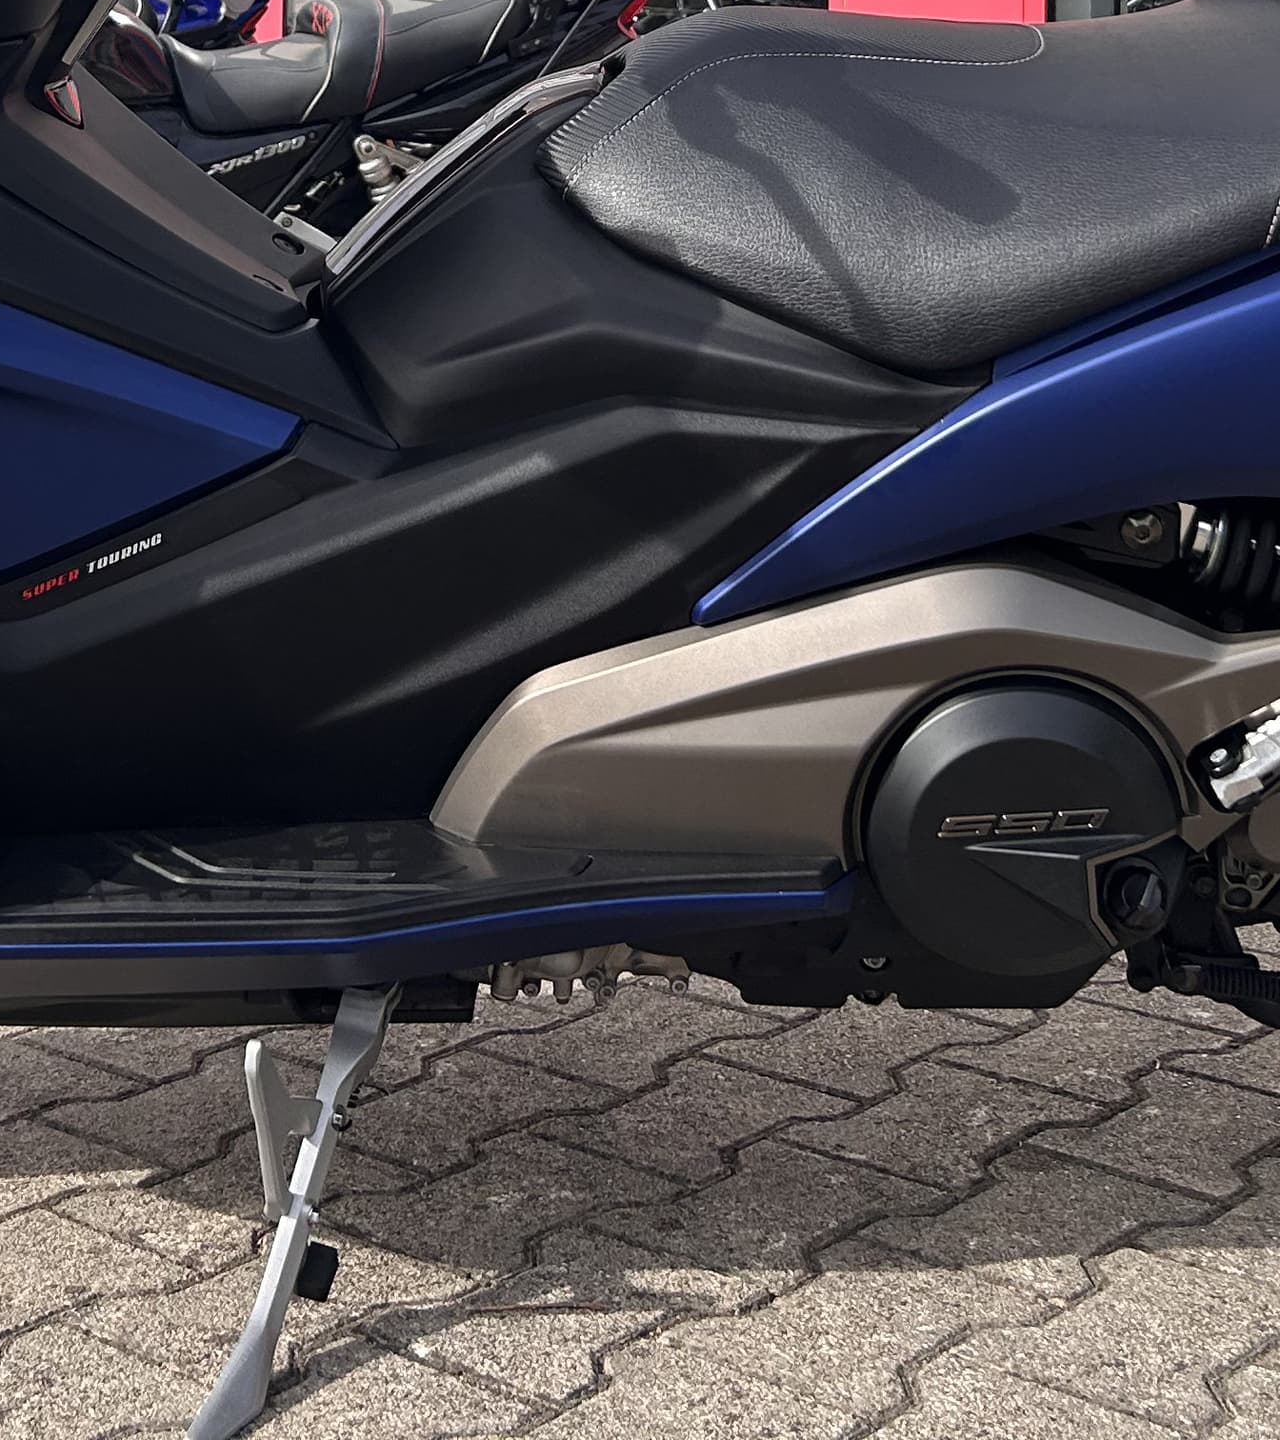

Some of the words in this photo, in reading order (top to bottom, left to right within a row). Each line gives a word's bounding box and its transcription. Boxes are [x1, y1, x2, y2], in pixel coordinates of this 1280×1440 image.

[22, 568, 81, 601] SUPER
[86, 532, 163, 574] TOURING
[936, 808, 1110, 839] 550
